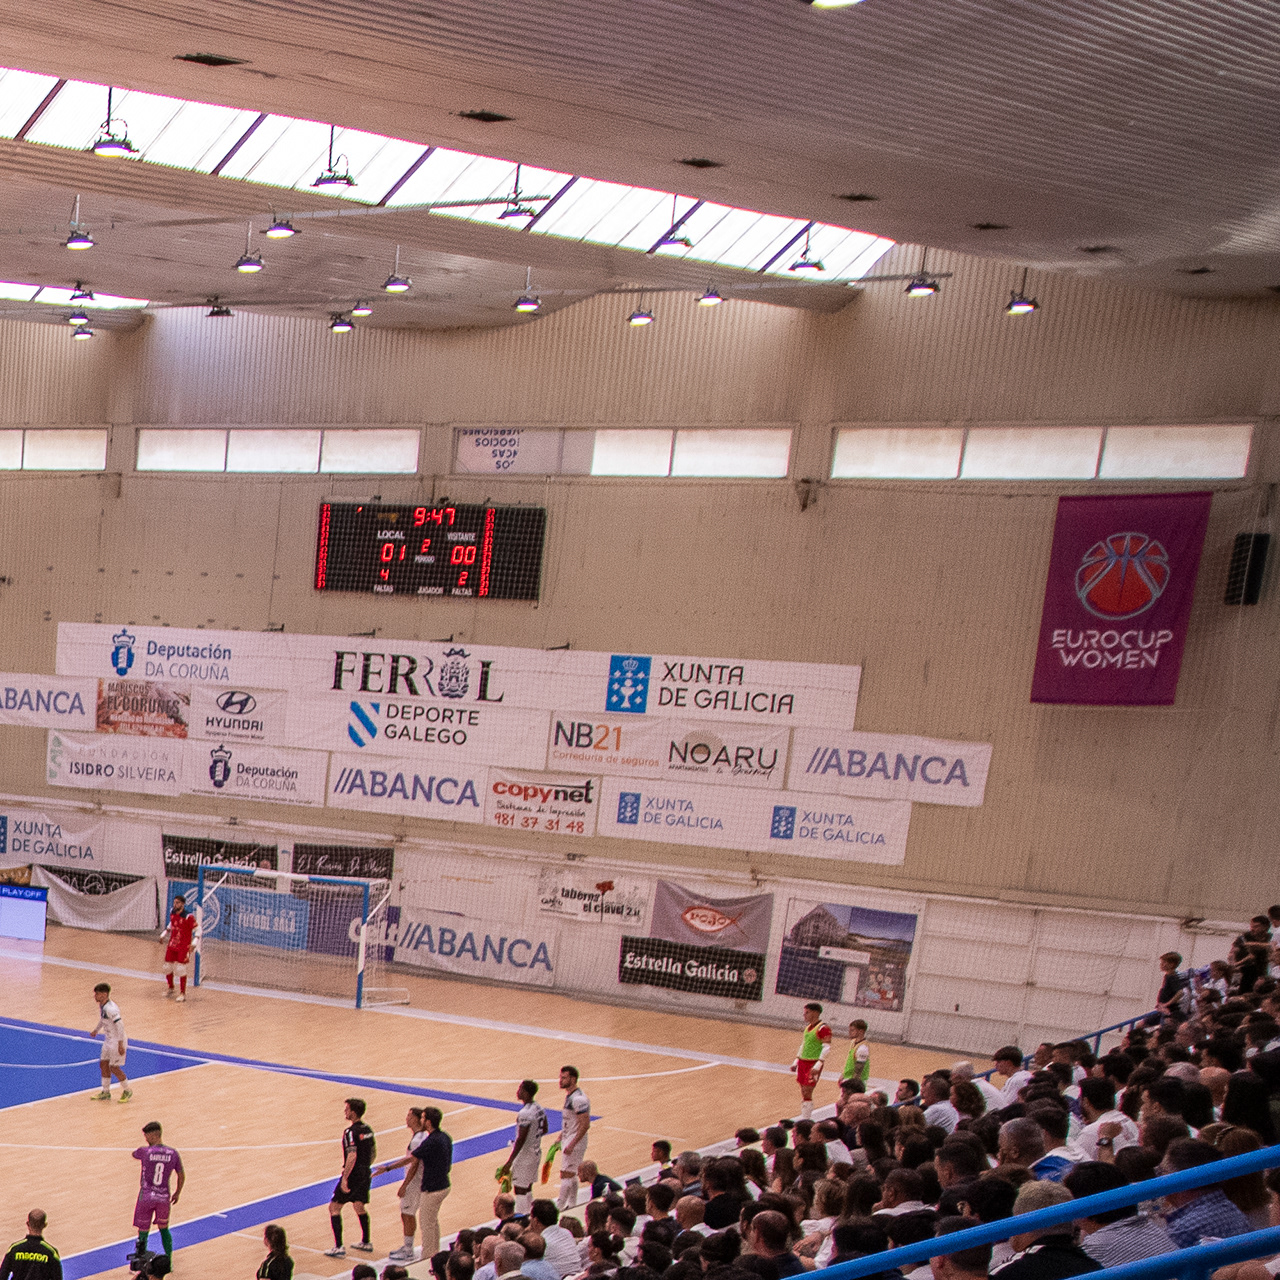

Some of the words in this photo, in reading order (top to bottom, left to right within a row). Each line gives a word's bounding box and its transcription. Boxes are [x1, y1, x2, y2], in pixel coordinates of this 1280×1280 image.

[414, 507, 456, 527] 9:47
[377, 530, 405, 539] LOCAL
[381, 543, 406, 562] 01
[421, 538, 431, 553] 2
[451, 545, 477, 565] 00
[380, 568, 390, 581] 4
[458, 571, 468, 586] 2
[373, 584, 393, 593] FALTAS
[451, 587, 472, 596] FALTAS
[1052, 629, 1174, 649] EUROCUP
[147, 641, 232, 661] Deputación
[1059, 649, 1160, 669] WOMEN
[145, 662, 165, 676] DA
[169, 663, 230, 681] CORUÑA
[662, 662, 744, 685] XUNTA
[658, 687, 688, 706] DE
[694, 689, 794, 714] GALICIA
[206, 717, 263, 731] HYUNDAI
[386, 704, 480, 726] DEPORTE
[384, 724, 467, 745] GALEGO
[554, 720, 622, 751] NB21
[606, 754, 618, 764] de
[621, 756, 660, 767] seguros
[668, 740, 778, 769] NOARU
[70, 762, 114, 778] ISIDRO
[118, 765, 176, 782] SILVEIRA
[237, 763, 299, 778] Deputación
[236, 776, 250, 787] DA
[253, 777, 297, 791] CORUÑA
[492, 780, 594, 804] copynet
[646, 797, 694, 812] XUNTA
[494, 812, 515, 826] 981
[520, 816, 538, 829] 37
[545, 818, 560, 831] 31
[566, 821, 584, 834] 48
[644, 812, 661, 824] DE
[665, 814, 723, 830] GALICIA
[802, 810, 854, 826] XUNTA
[13, 819, 63, 839] XUNTA
[799, 826, 818, 840] DE
[823, 828, 886, 845] GALICIA
[11, 838, 31, 853] DE
[33, 840, 94, 861] GALICIA
[165, 848, 211, 865] Estrella
[623, 952, 682, 976] Estrella
[685, 959, 738, 982] Galicia
[153, 1162, 165, 1185] 8
[15, 1250, 48, 1263] macron
